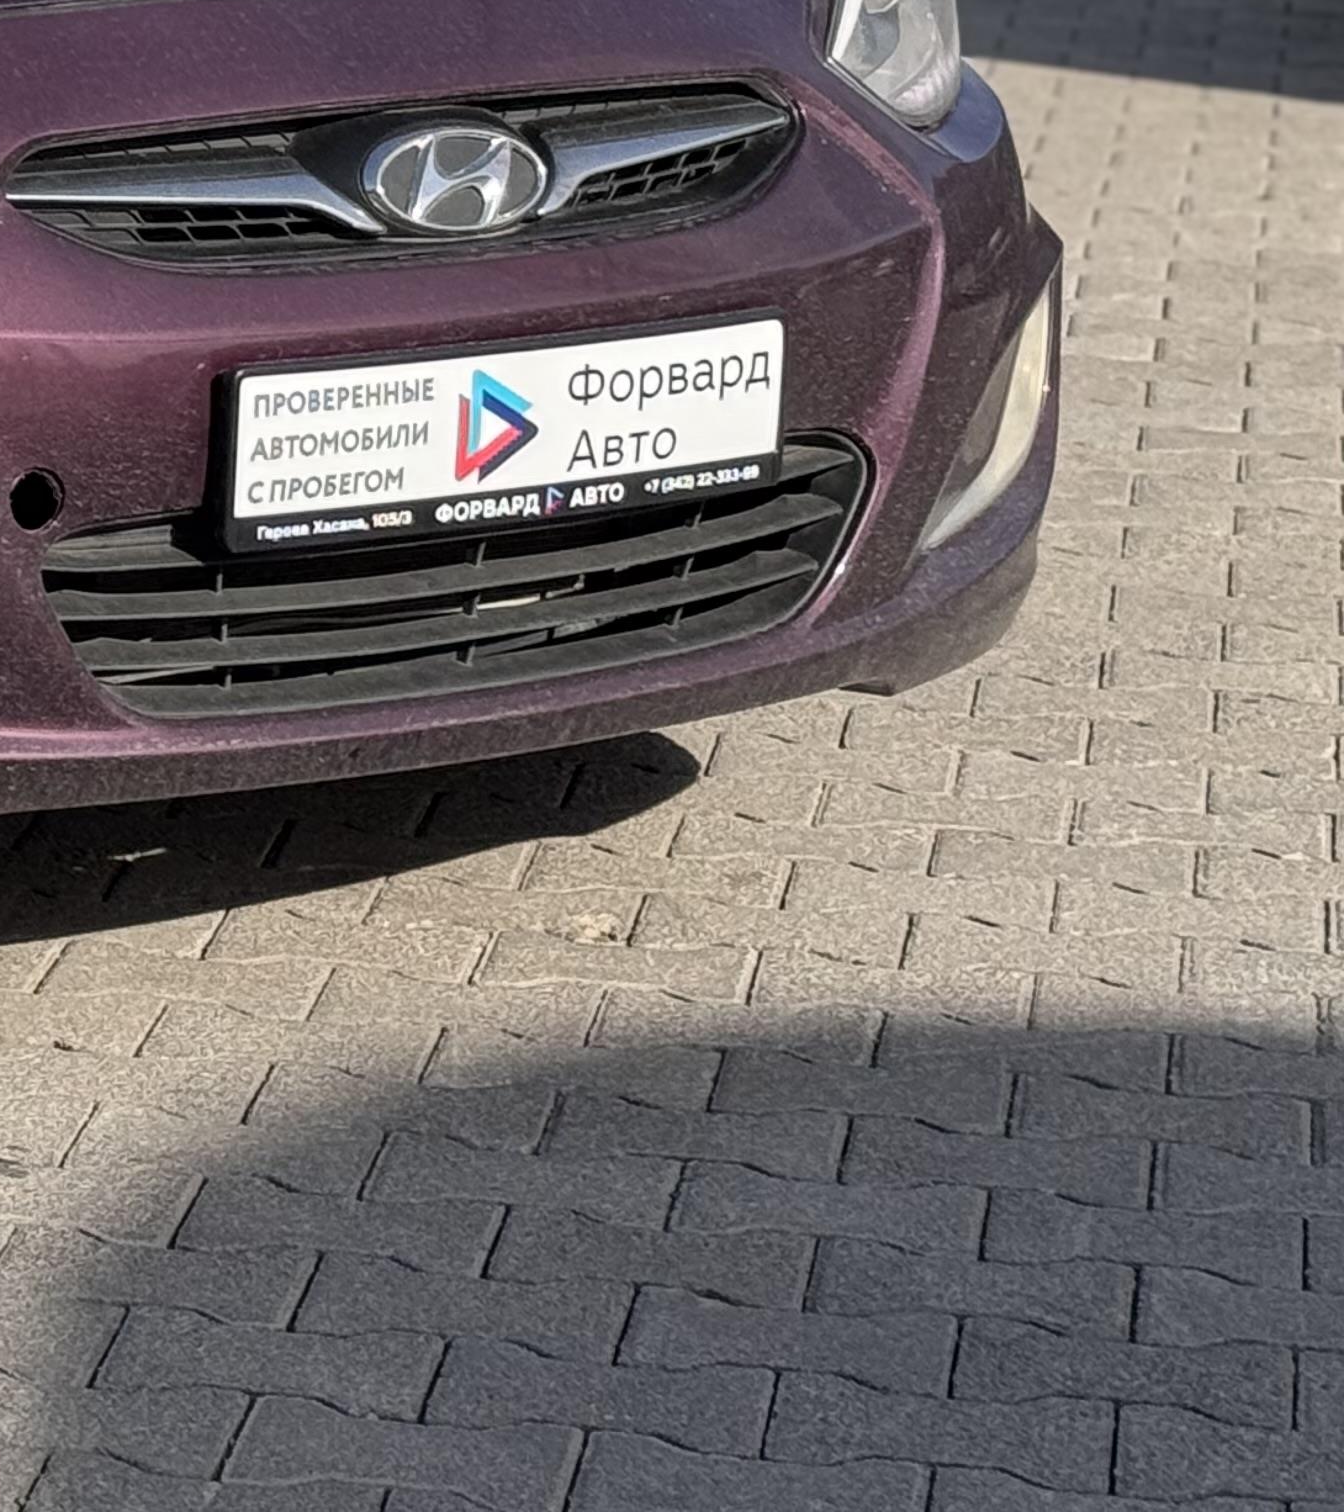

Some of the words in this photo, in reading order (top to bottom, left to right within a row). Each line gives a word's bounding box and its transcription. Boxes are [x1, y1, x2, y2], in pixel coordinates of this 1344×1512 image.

[254, 377, 434, 418] ПРОВЕРЕННЫЕ
[568, 351, 770, 411] Форвард
[250, 421, 429, 462] АВТОМОБИЛИ
[567, 427, 677, 472] Авто
[247, 481, 264, 504] С
[269, 467, 404, 503] ПРОБЕГОМ
[435, 492, 540, 523] ФОРВАРД
[569, 482, 624, 508] АВТО
